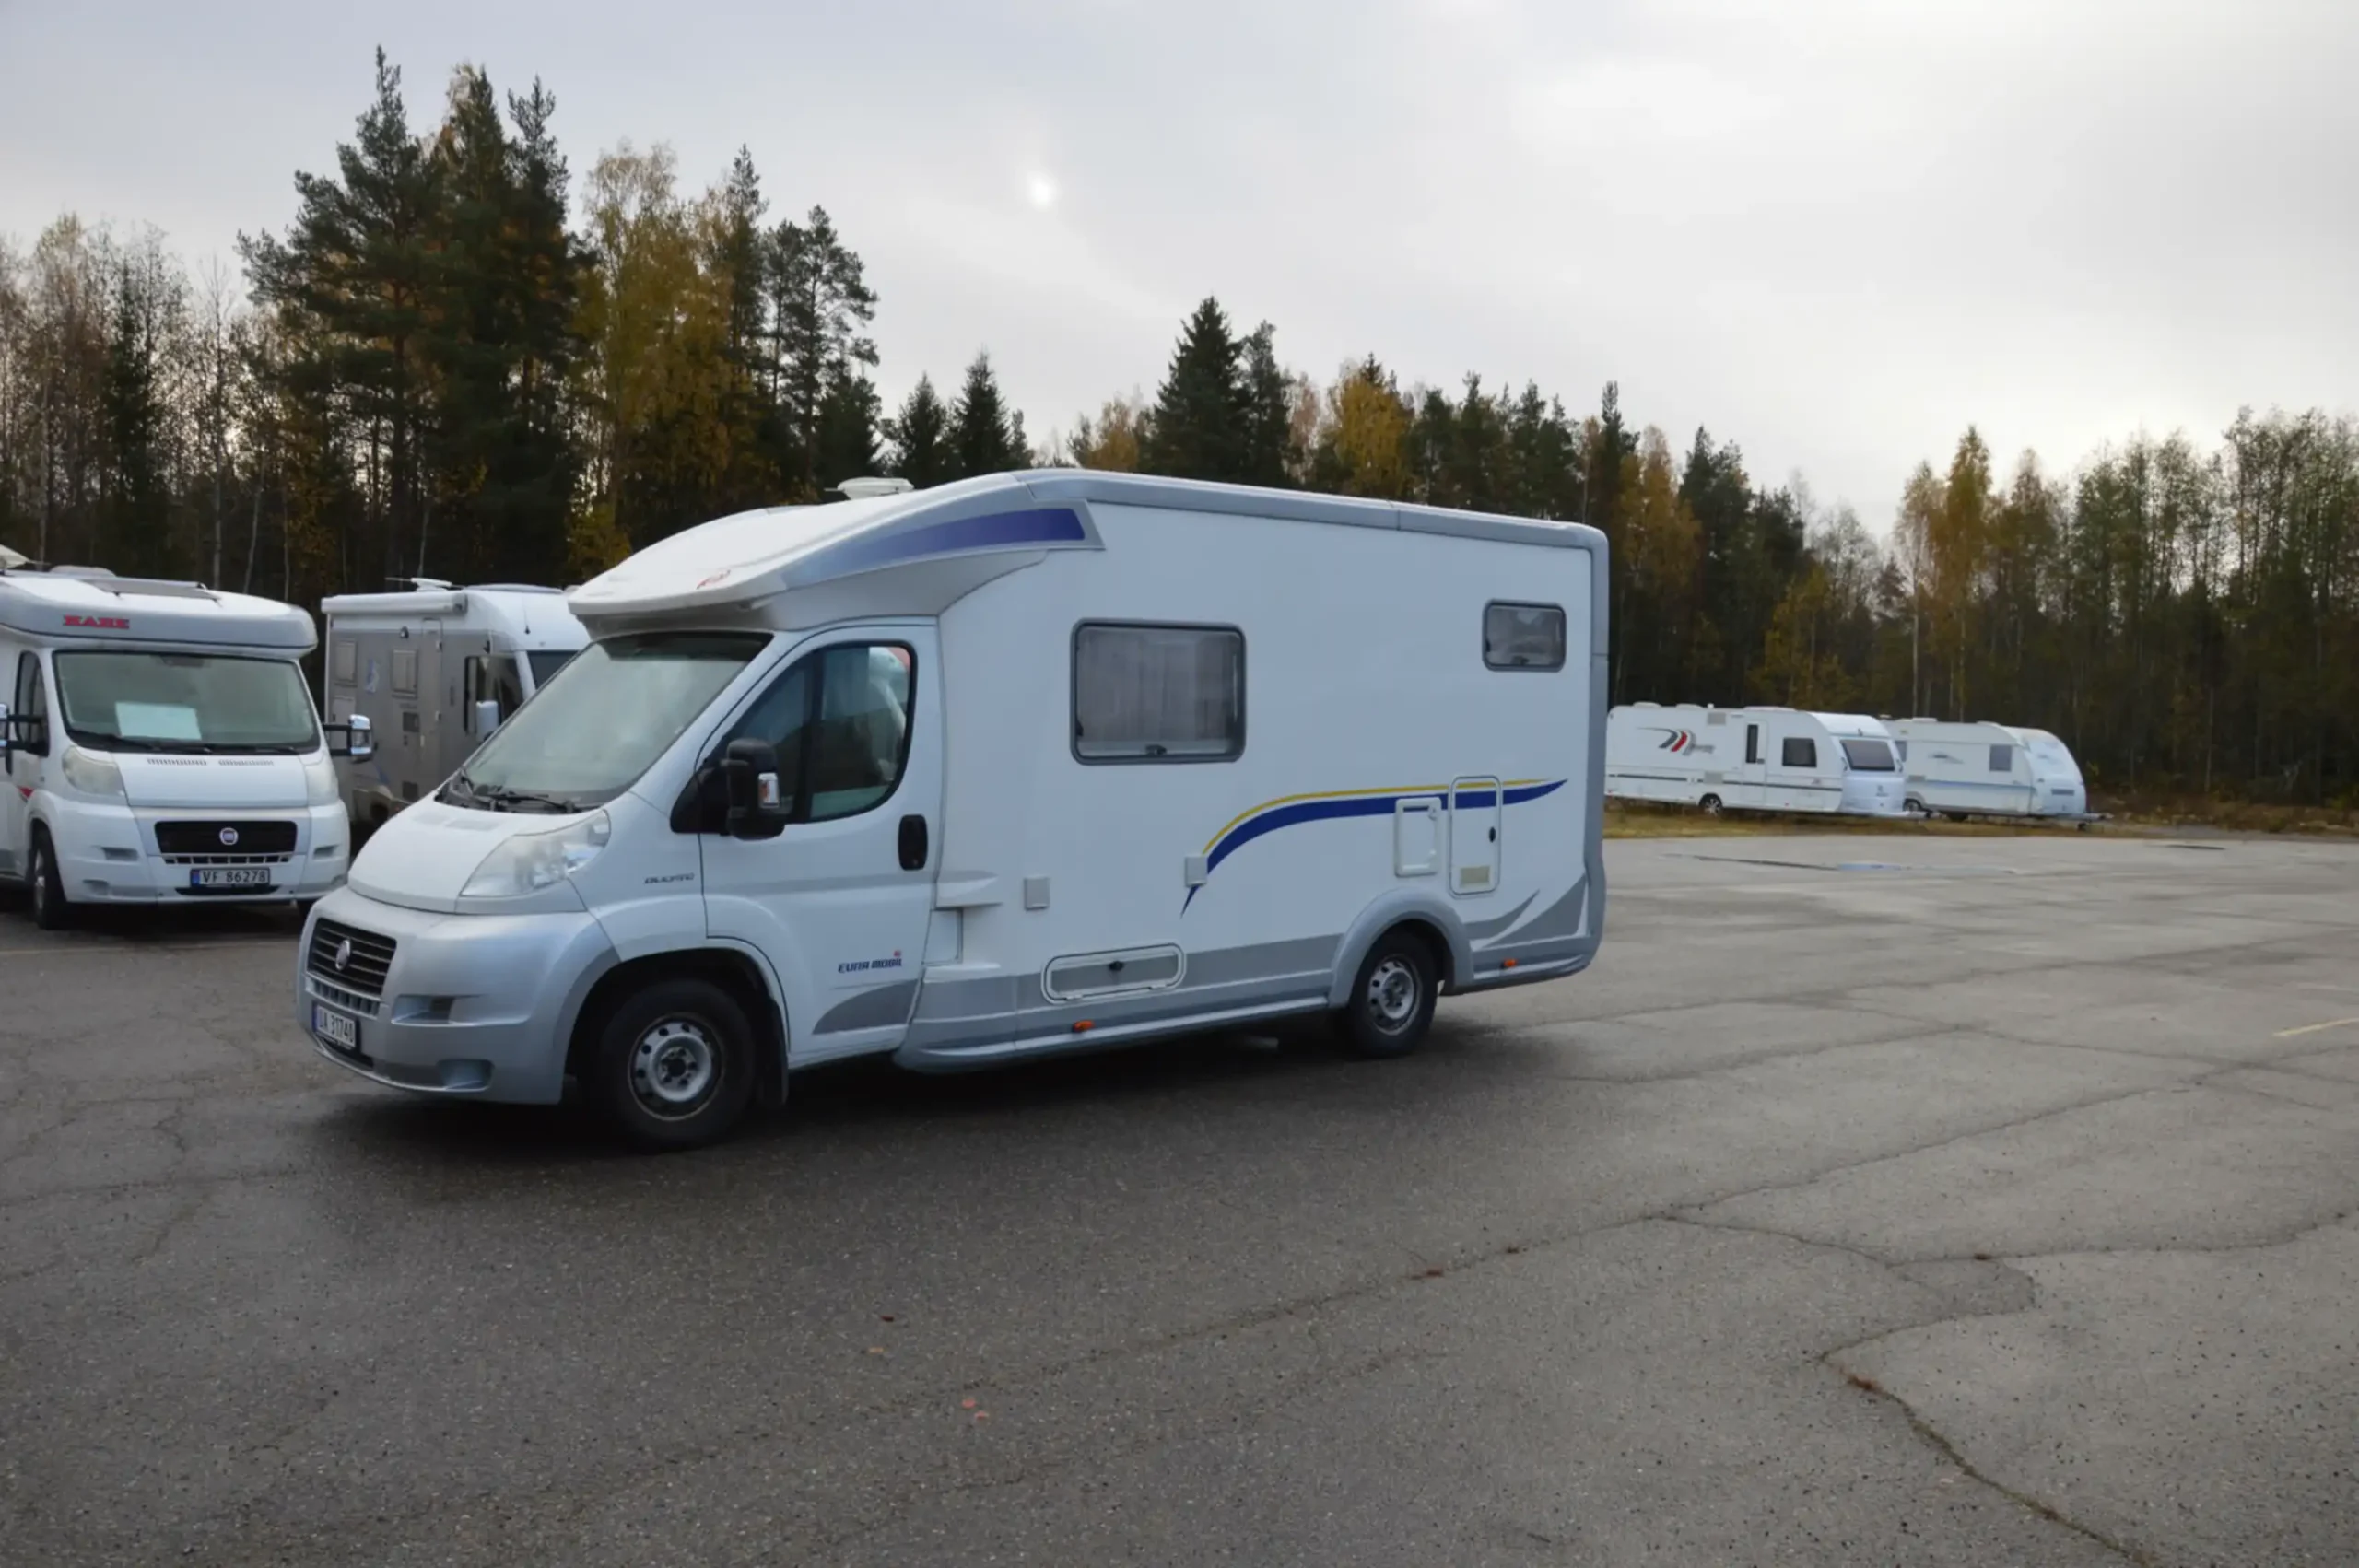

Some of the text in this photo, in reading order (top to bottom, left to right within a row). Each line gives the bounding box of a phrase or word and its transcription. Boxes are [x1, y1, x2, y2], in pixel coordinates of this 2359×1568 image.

[203, 871, 266, 883] VF 86278
[871, 958, 902, 969] MOBIL
